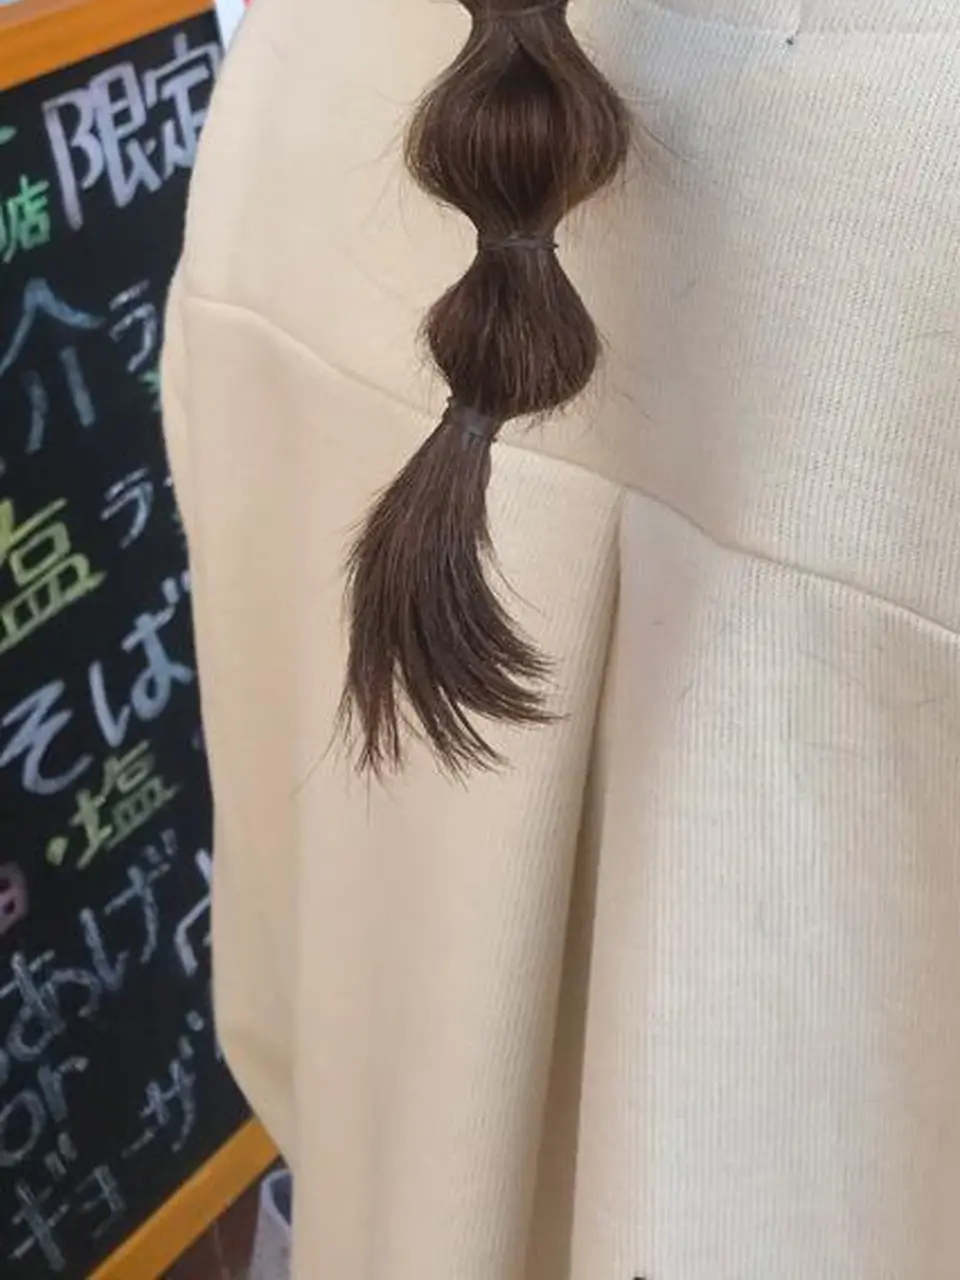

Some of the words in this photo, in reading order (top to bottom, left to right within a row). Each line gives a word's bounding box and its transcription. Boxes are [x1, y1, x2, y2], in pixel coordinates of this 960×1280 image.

[0, 173, 50, 263] 店
[41, 32, 220, 232] 限定
[0, 829, 178, 1065] あげ
